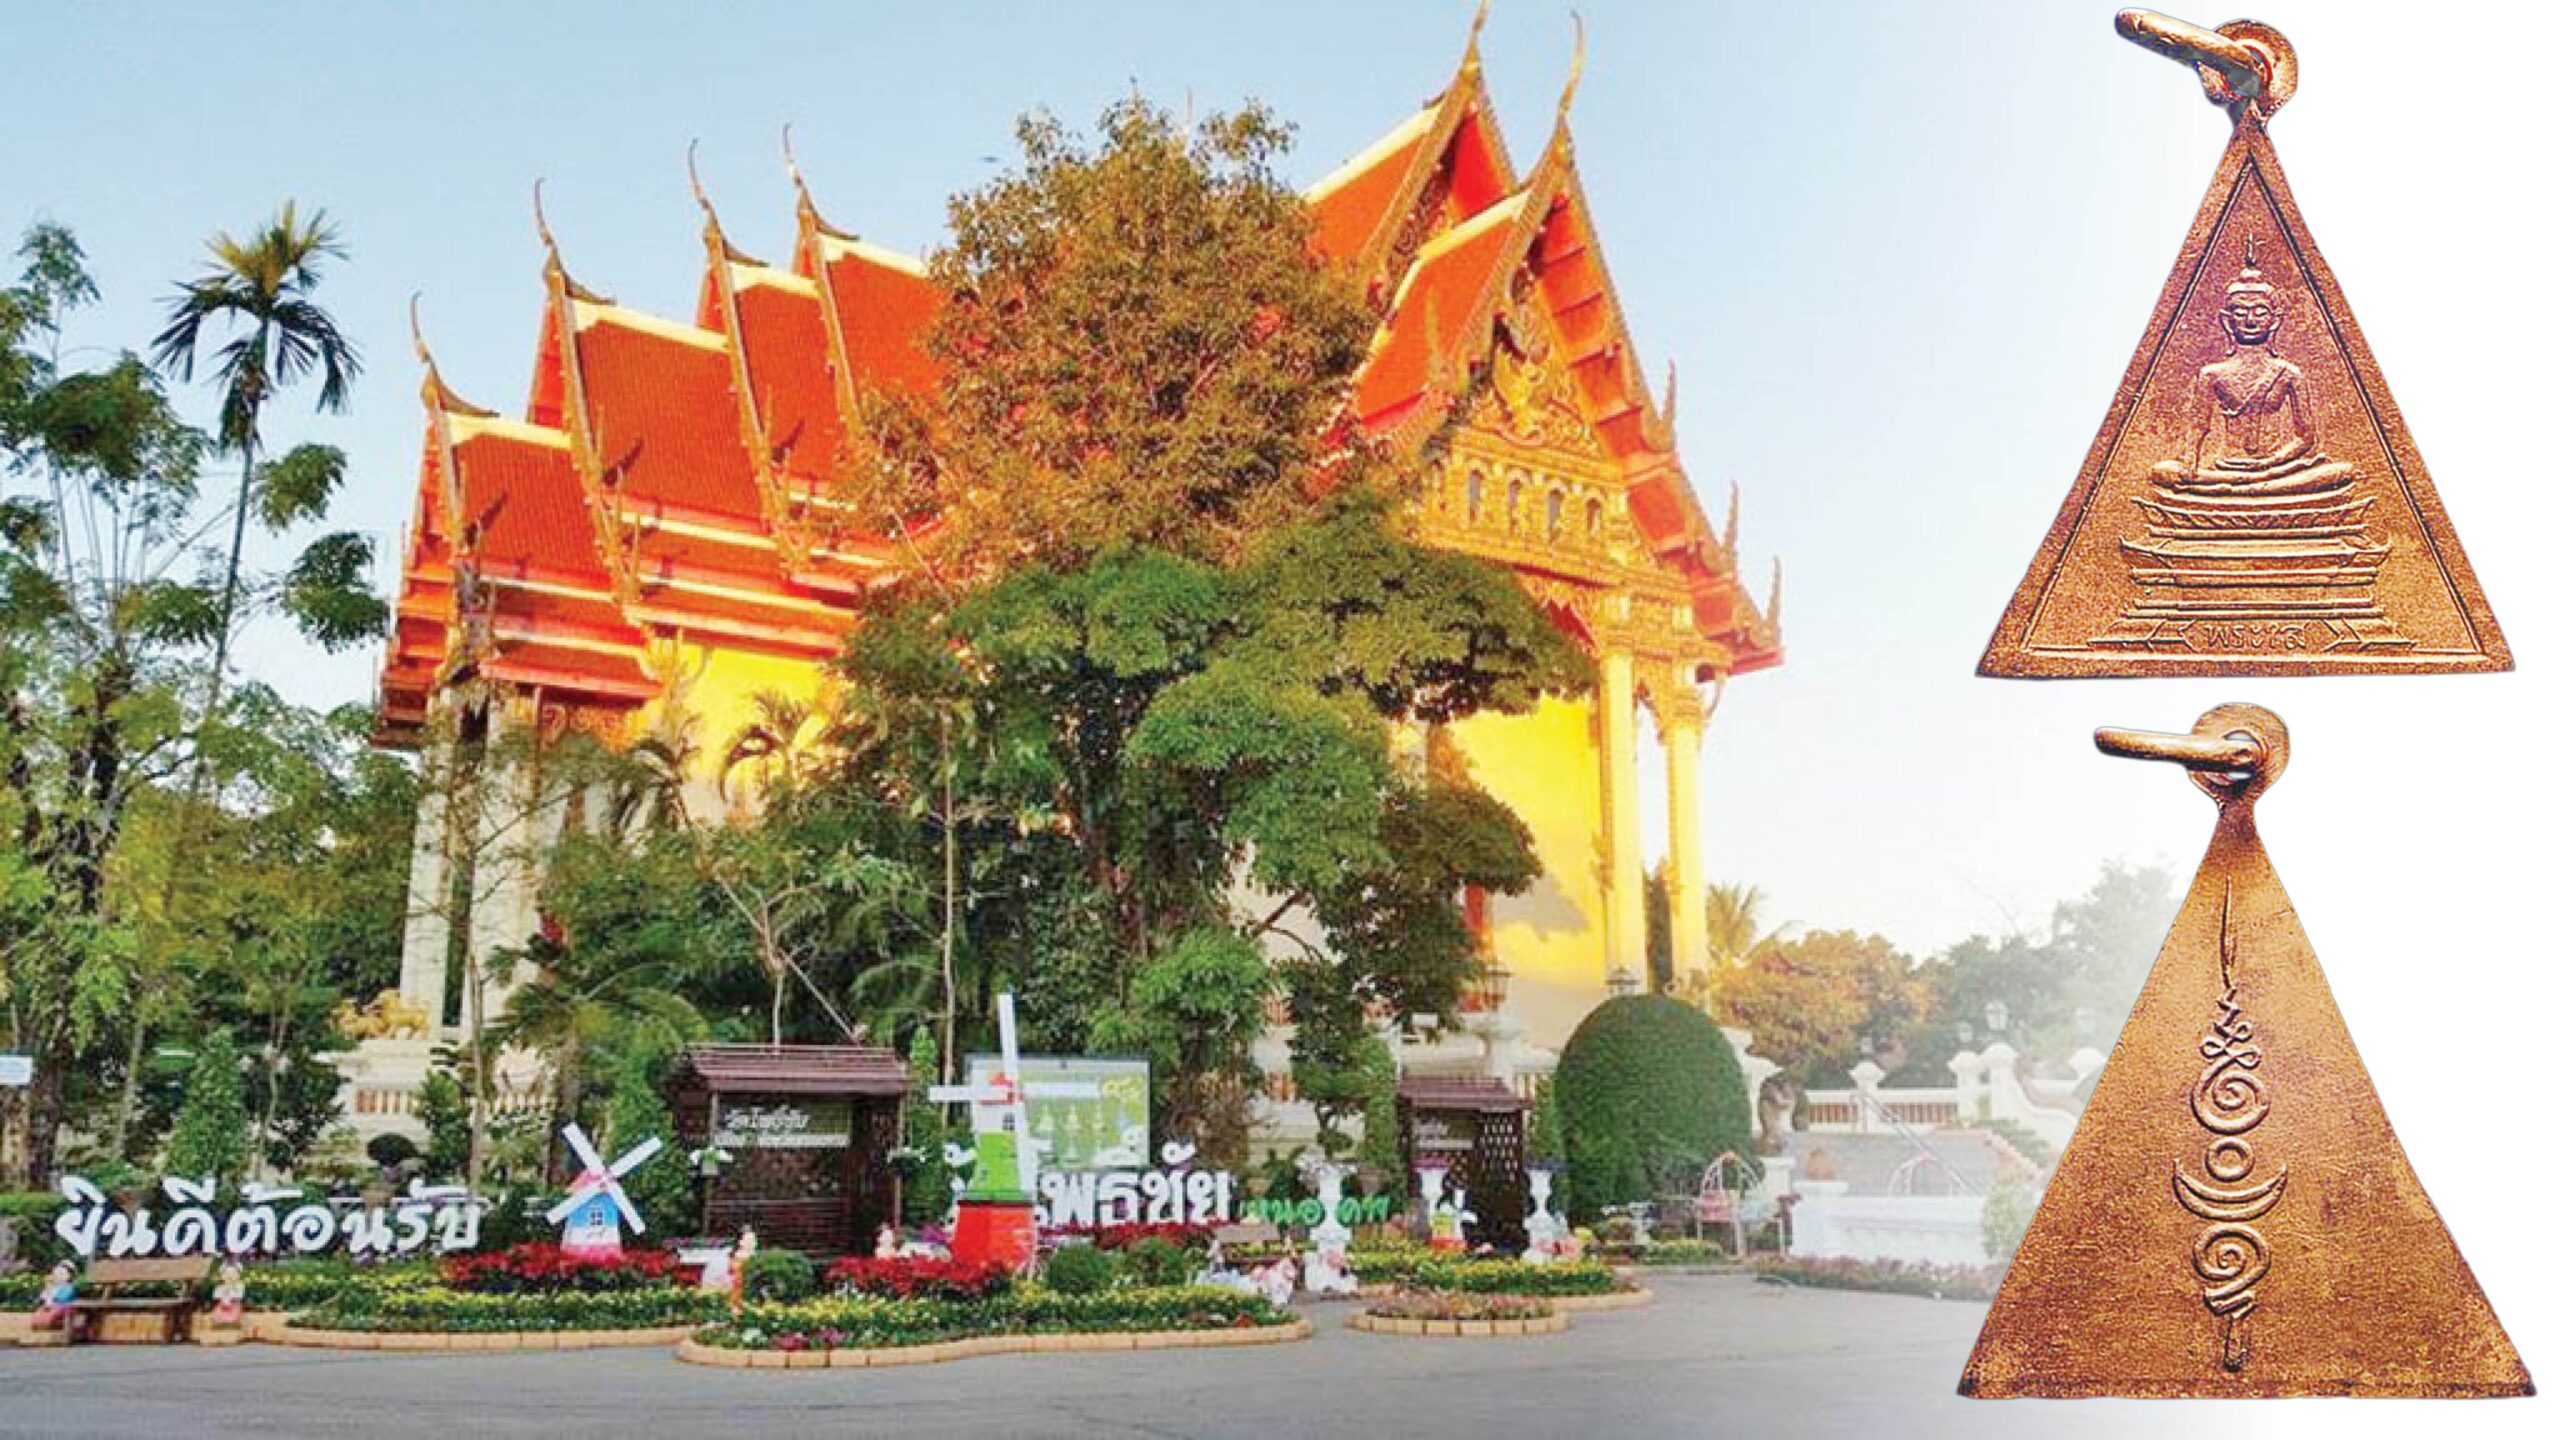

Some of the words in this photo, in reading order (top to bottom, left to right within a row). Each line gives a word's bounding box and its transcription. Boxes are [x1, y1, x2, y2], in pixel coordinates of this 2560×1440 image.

[54, 1174, 486, 1257] ยินดีต้อนรับ
